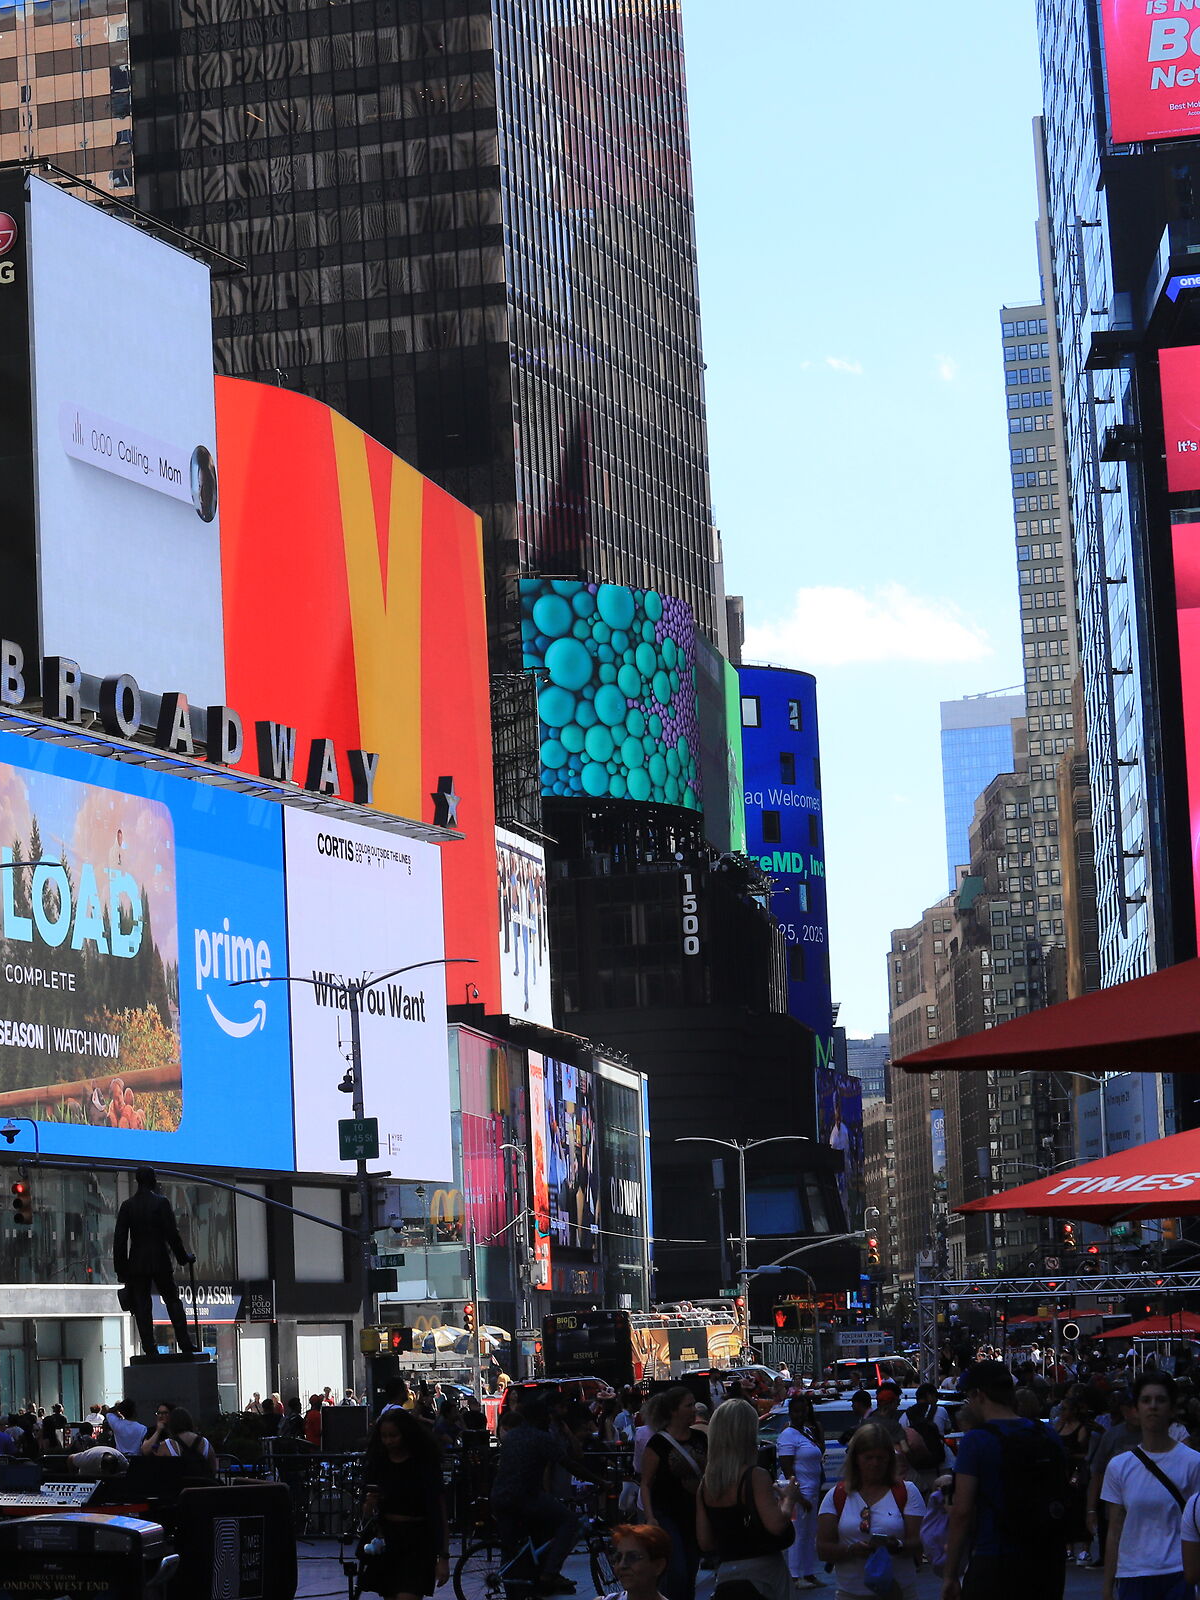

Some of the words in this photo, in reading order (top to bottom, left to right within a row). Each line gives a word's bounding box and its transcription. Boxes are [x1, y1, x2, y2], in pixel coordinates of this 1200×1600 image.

[159, 457, 183, 486] Mom
[1, 638, 380, 806] BROADWAY
[767, 787, 821, 811] Welcomes
[317, 832, 354, 862] CORTIS
[355, 842, 370, 855] COLOR
[371, 846, 389, 860] OUTSIDE
[390, 850, 398, 862] THE
[399, 852, 411, 865] LINES
[681, 873, 700, 958] 1500
[802, 922, 825, 945] 2025
[194, 917, 272, 990] prime
[4, 963, 77, 992] COMPLETE
[356, 977, 386, 1017] You
[387, 982, 426, 1023] Want
[53, 1026, 93, 1056] WATCH
[94, 1031, 120, 1059] NOW
[344, 1135, 351, 1143] W
[353, 1135, 363, 1143] 45
[353, 1123, 363, 1132] TO
[610, 1176, 624, 1216] OLD
[624, 1181, 641, 1218] NAVY
[1047, 1172, 1200, 1196] TIMES
[206, 1285, 235, 1305] ASSN.
[251, 1301, 271, 1309] POLO
[768, 1344, 814, 1363] BROADWAY'S
[54, 1580, 83, 1591] WEST
[86, 1580, 110, 1591] END
